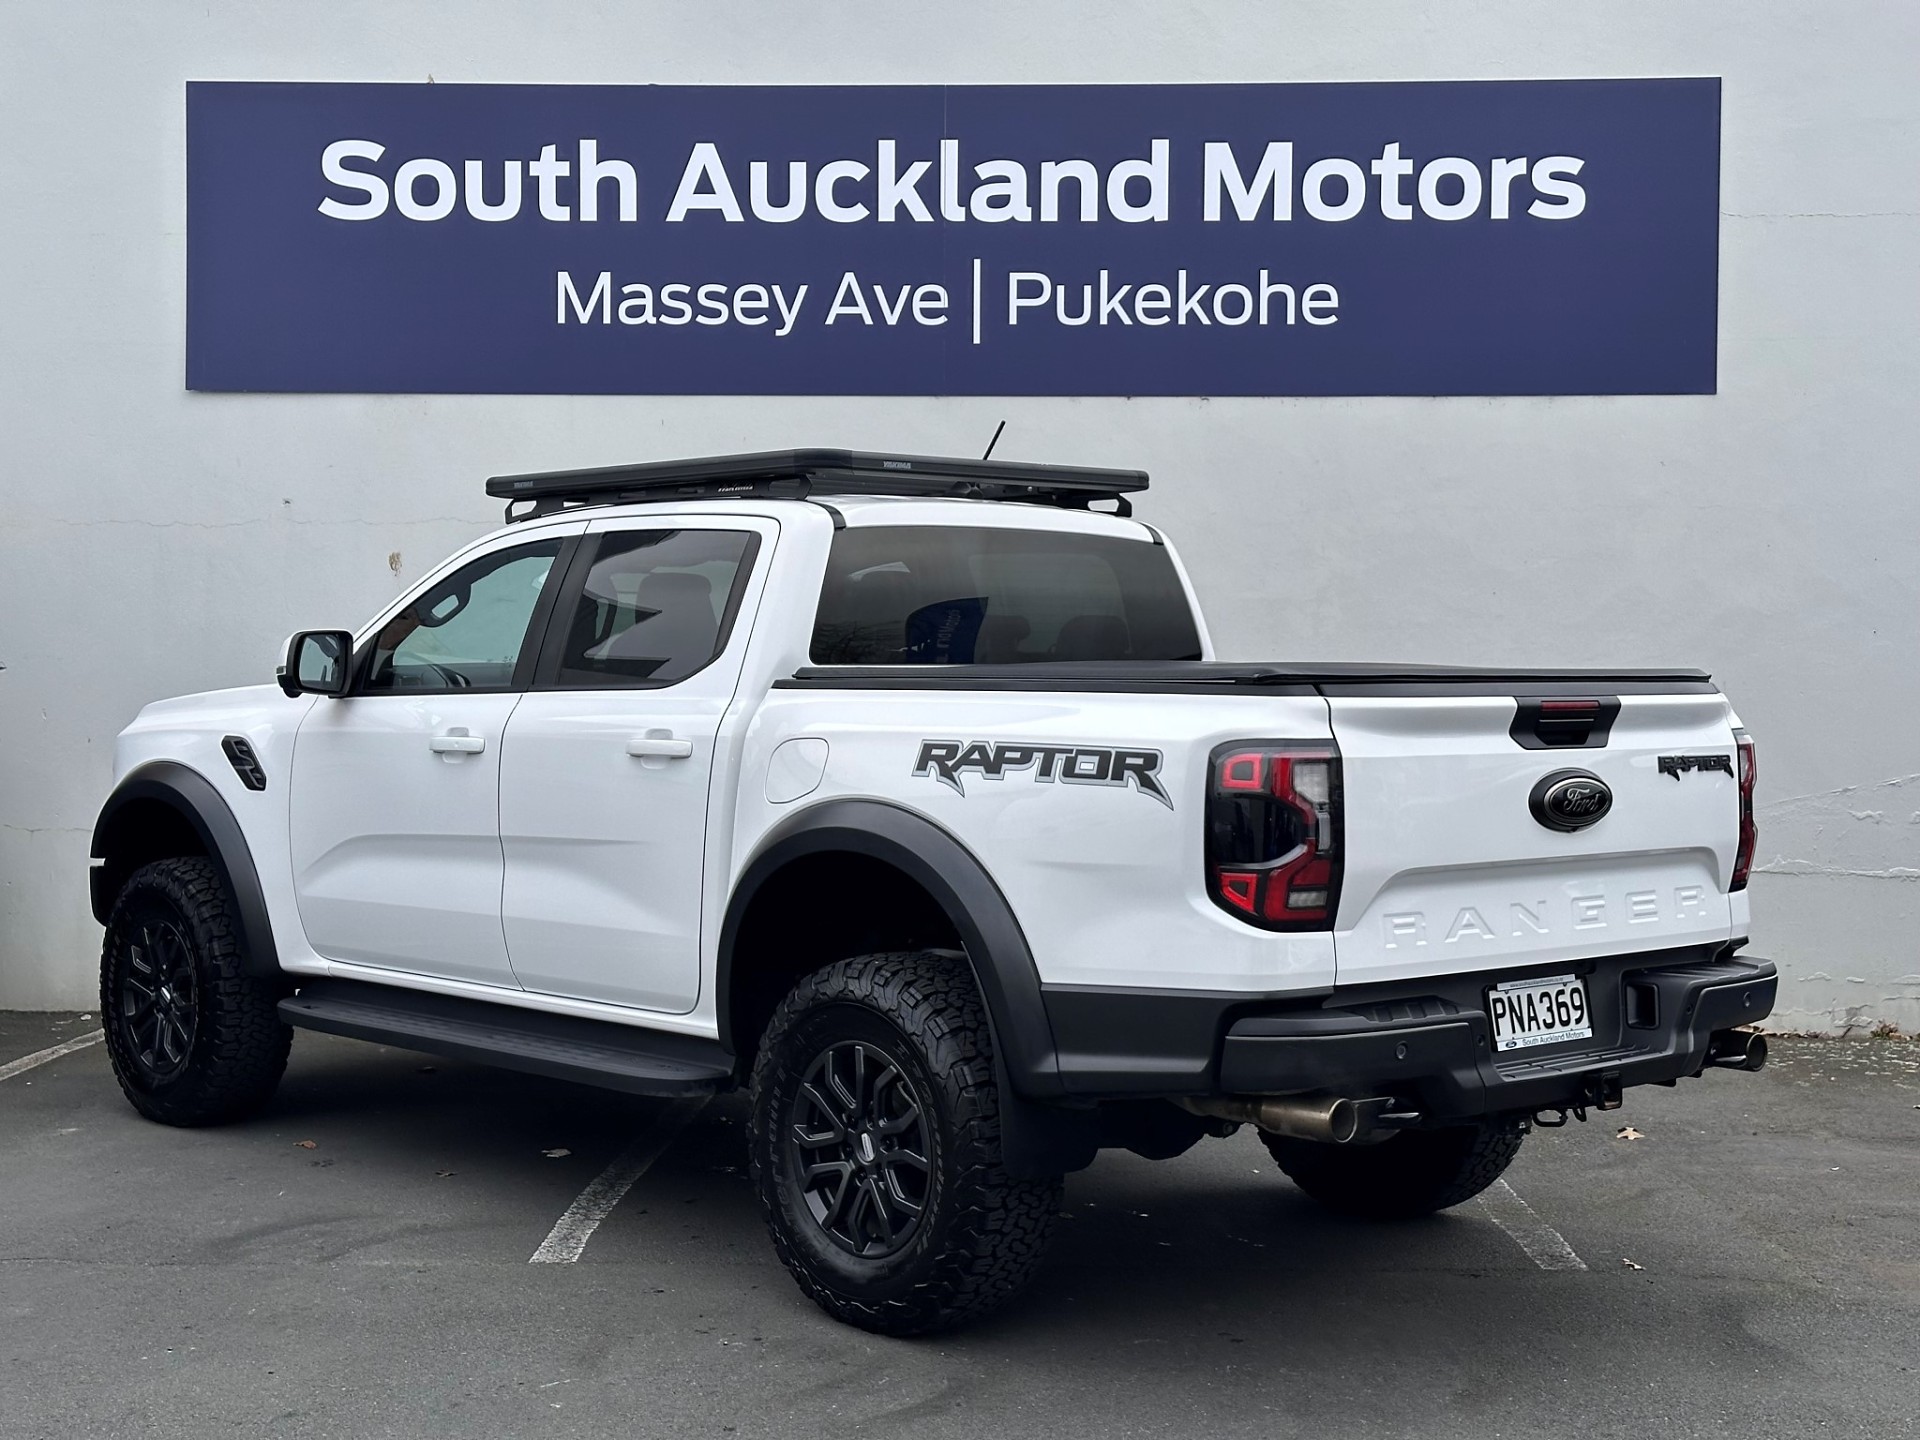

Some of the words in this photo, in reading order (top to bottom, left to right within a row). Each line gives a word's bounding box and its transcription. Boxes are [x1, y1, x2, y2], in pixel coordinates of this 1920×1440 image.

[317, 139, 637, 222] South
[665, 138, 1170, 223] Auckland
[1203, 141, 1586, 222] Motors
[556, 271, 809, 337] Massey
[824, 271, 949, 326] Ave
[1008, 269, 1339, 326] Pukekohe
[911, 739, 1174, 811] RAPTOR
[1657, 755, 1734, 781] RAPTOR
[1563, 787, 1602, 813] Ford
[1382, 885, 1707, 949] RANGER
[1491, 986, 1585, 1037] PNA369
[1522, 1038, 1540, 1047] South
[1540, 1032, 1565, 1044] Auckland
[1565, 1030, 1585, 1041] Motors
